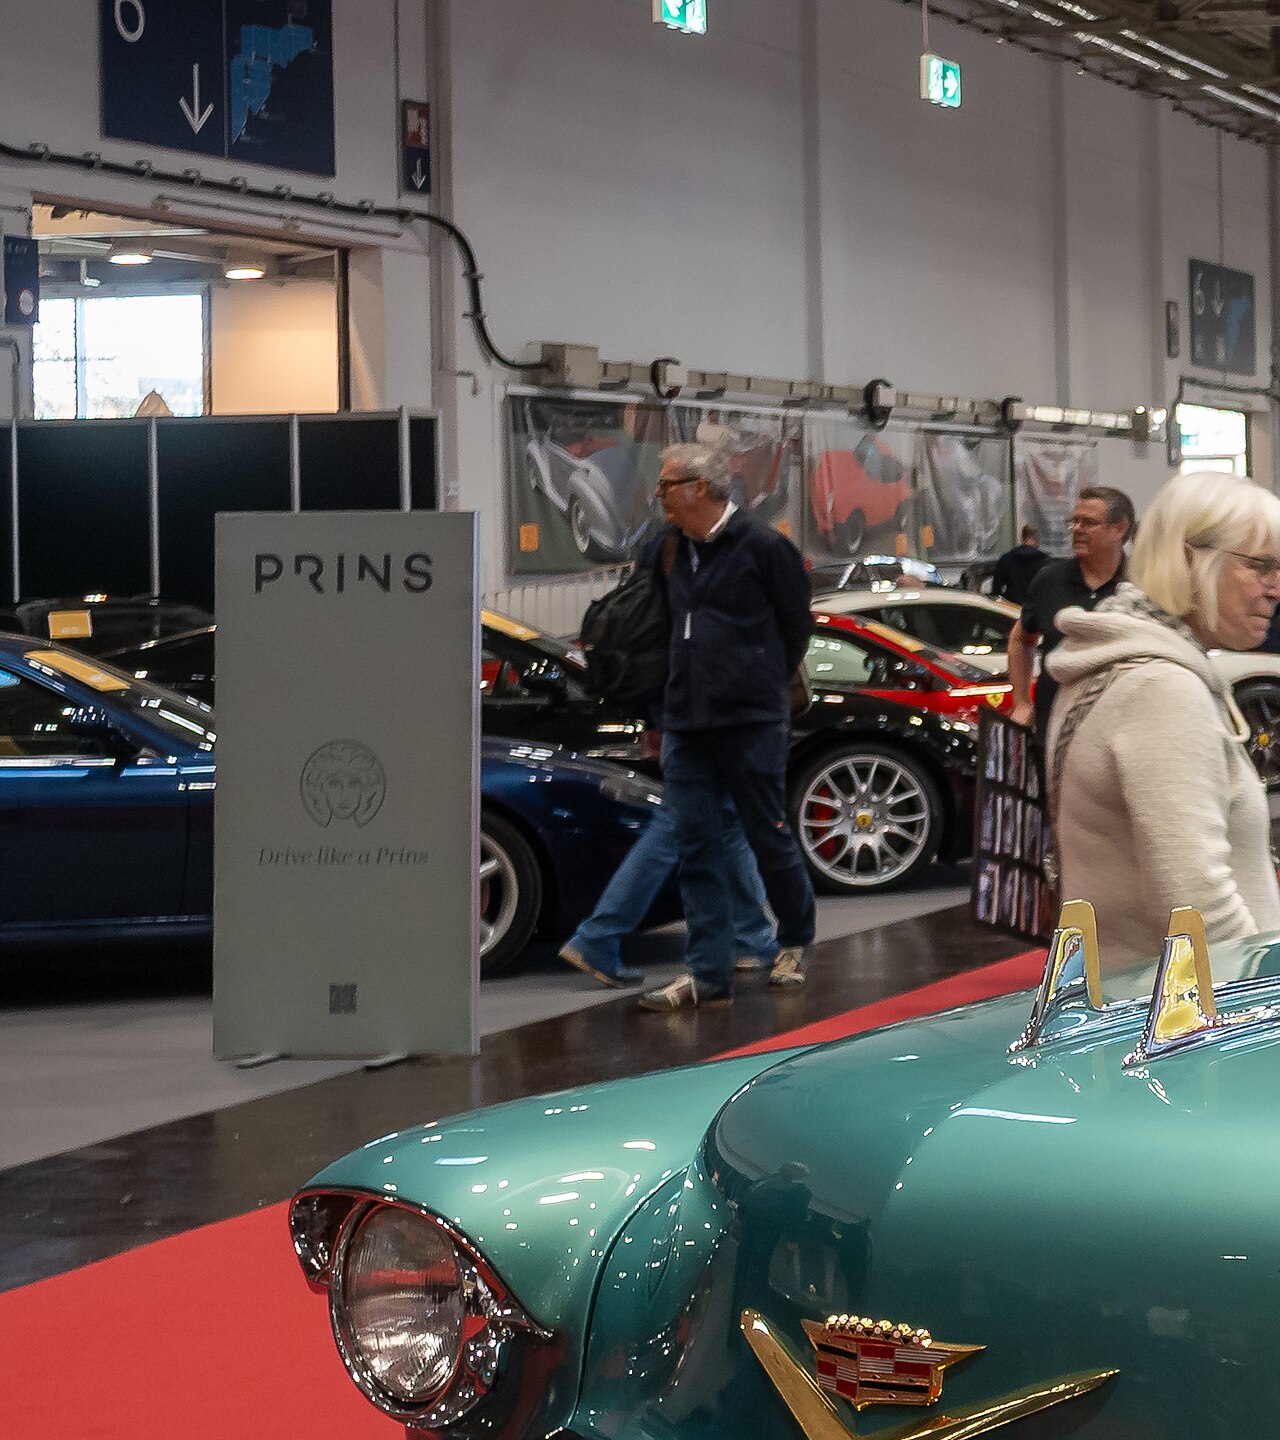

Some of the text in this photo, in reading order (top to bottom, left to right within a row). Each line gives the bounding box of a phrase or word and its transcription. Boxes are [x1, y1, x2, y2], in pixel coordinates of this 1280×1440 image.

[254, 552, 433, 594] PRINS
[258, 847, 430, 865] Drive like a Prins
